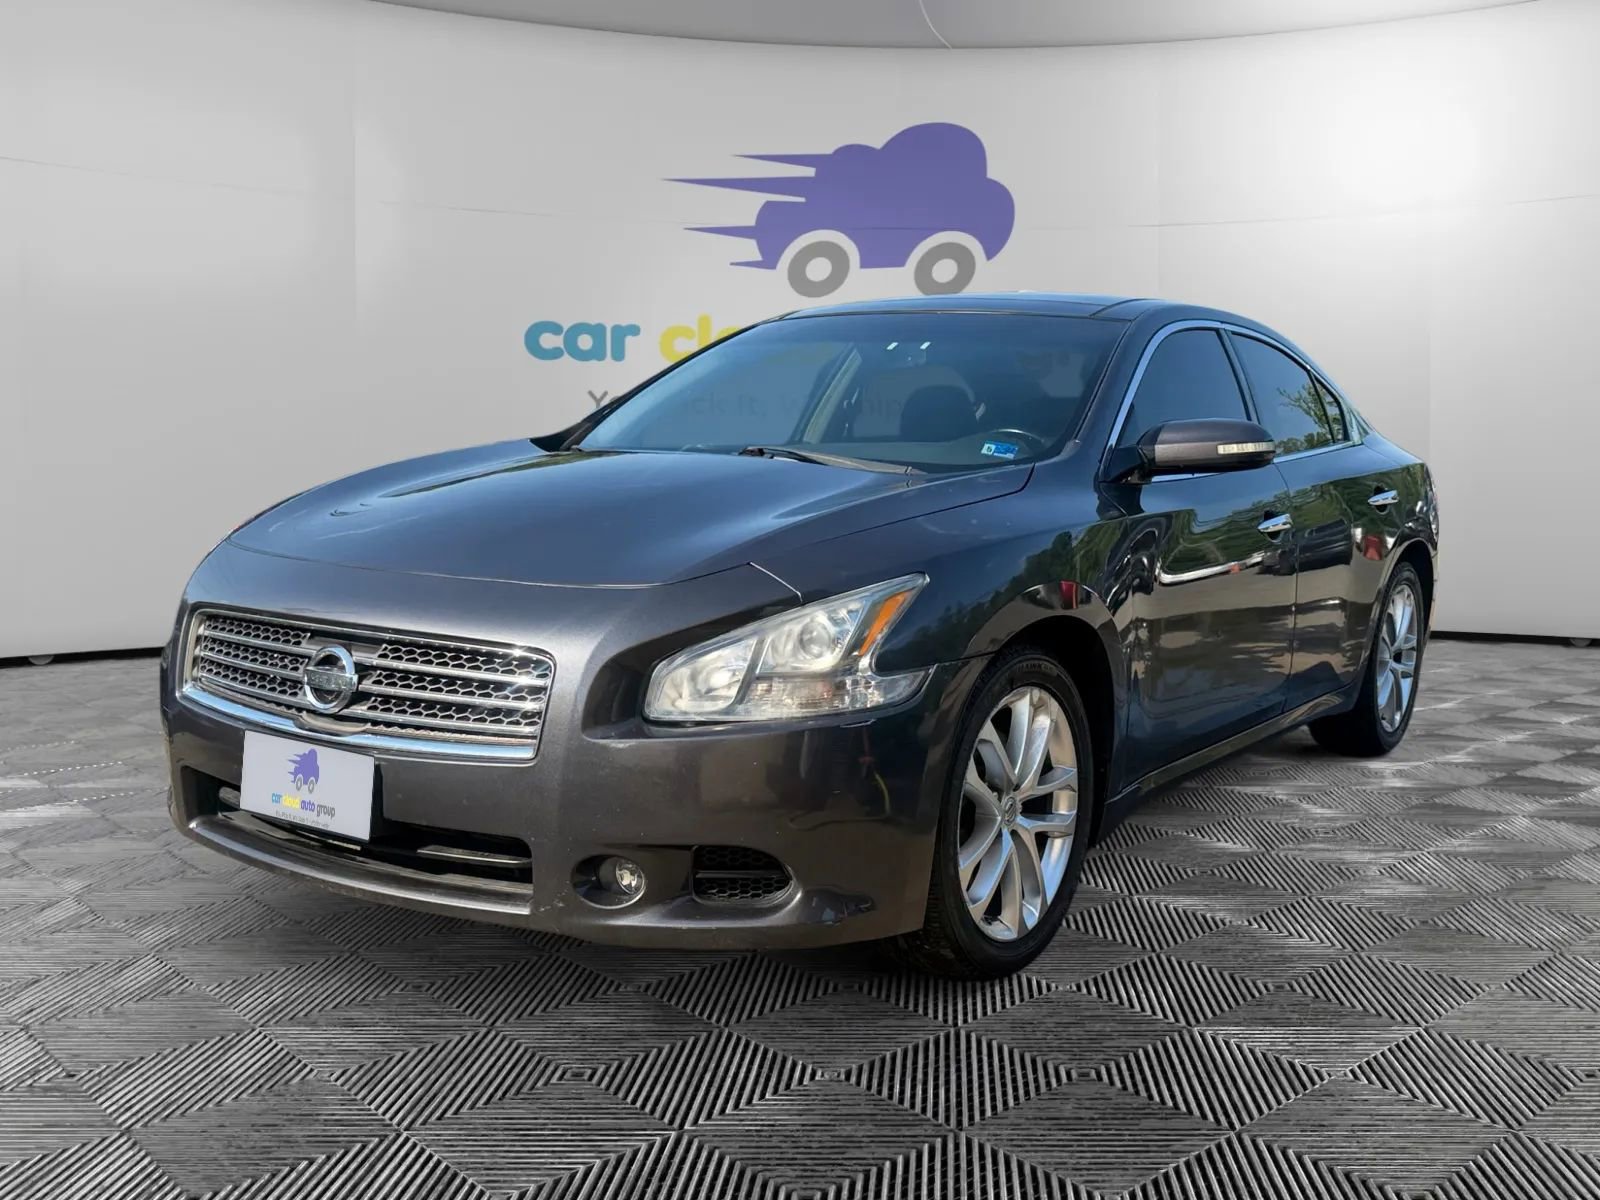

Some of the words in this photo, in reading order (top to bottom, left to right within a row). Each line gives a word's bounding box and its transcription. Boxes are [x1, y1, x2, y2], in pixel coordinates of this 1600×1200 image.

[524, 321, 640, 362] car
[271, 793, 282, 804] car
[301, 800, 315, 812] auto
[317, 804, 335, 819] group
